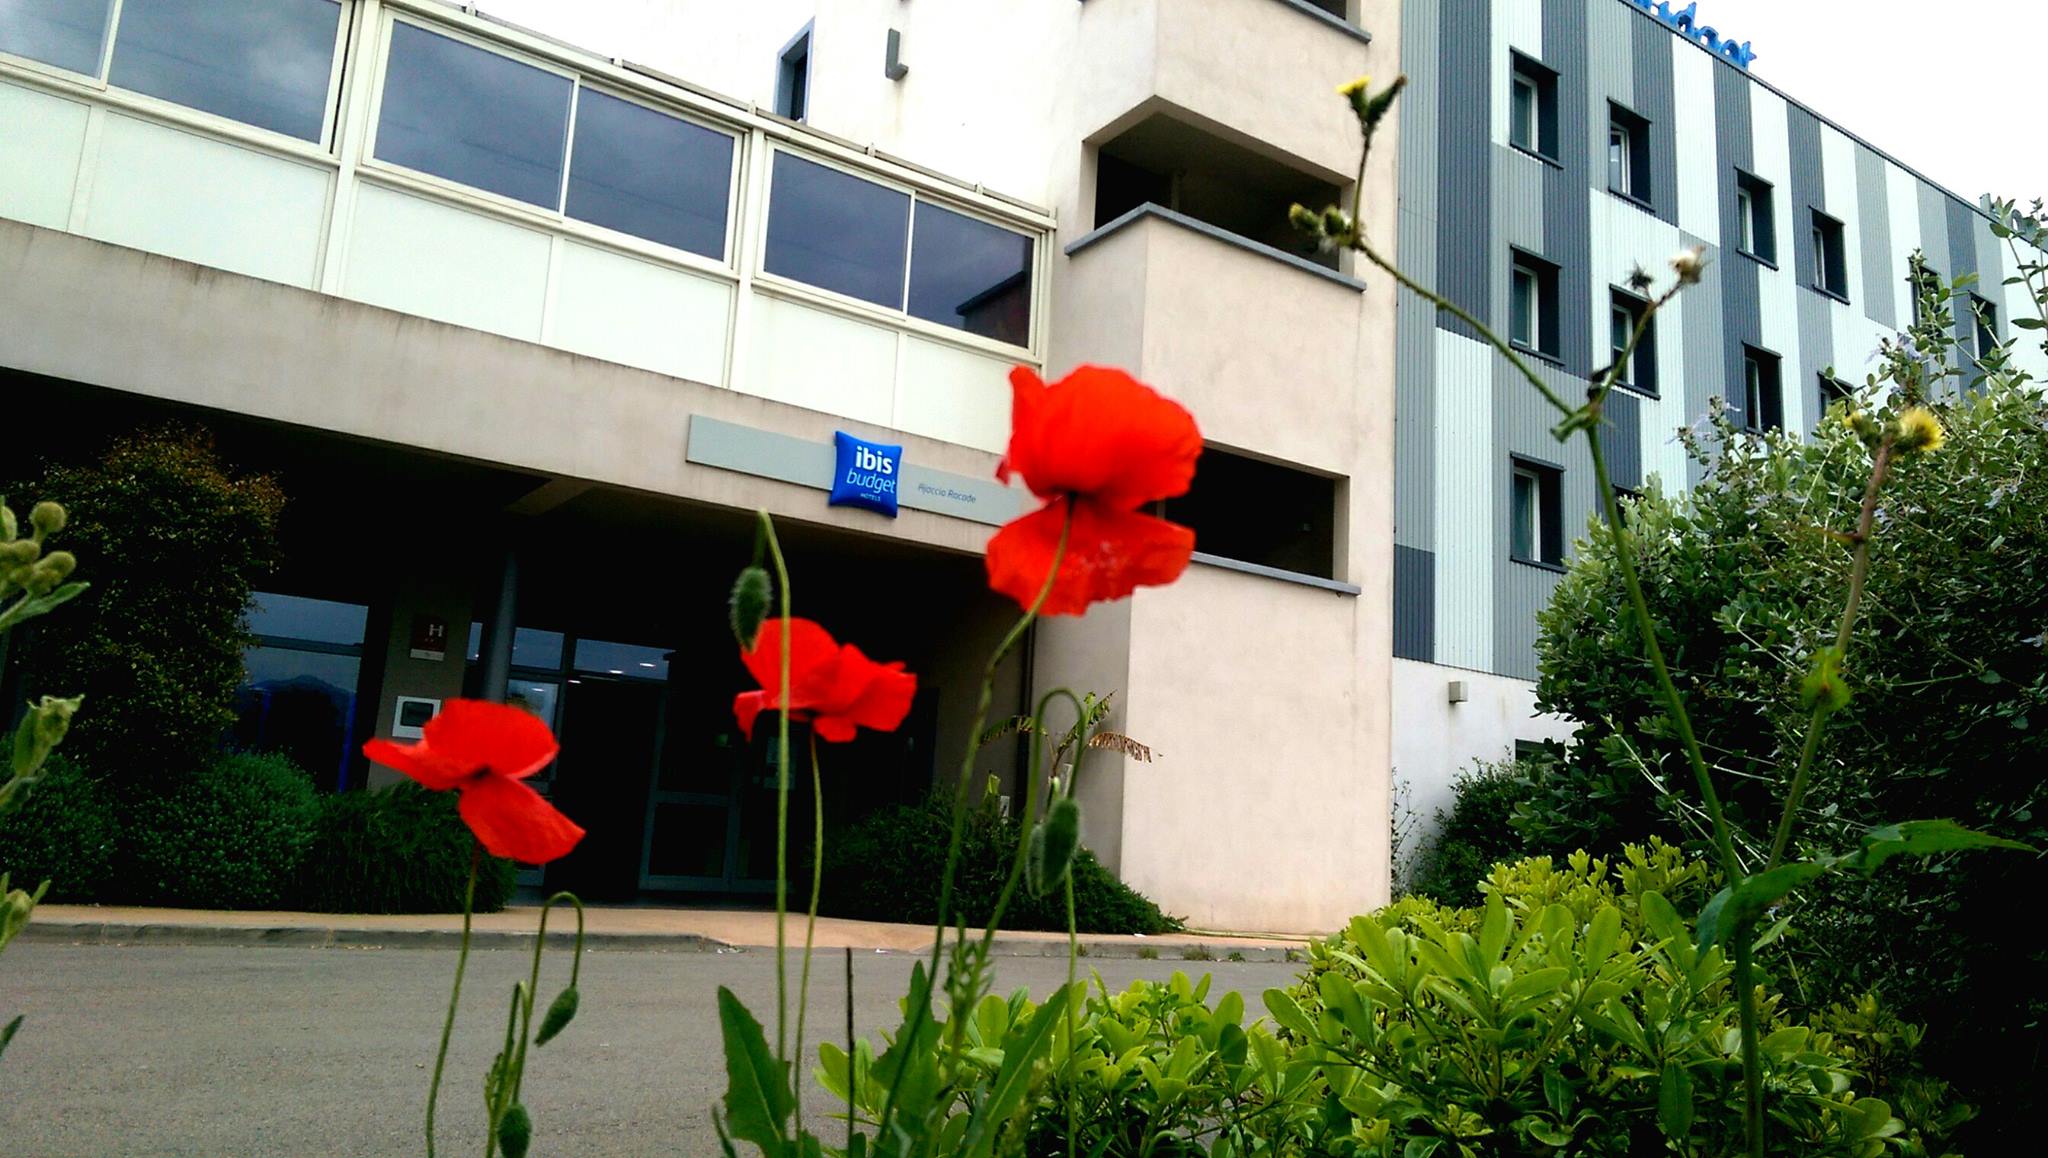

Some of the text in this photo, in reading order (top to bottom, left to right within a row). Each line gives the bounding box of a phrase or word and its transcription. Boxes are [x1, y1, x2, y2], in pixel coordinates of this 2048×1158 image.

[855, 445, 893, 475] ibis
[846, 467, 896, 494] budget
[429, 623, 444, 638] H
